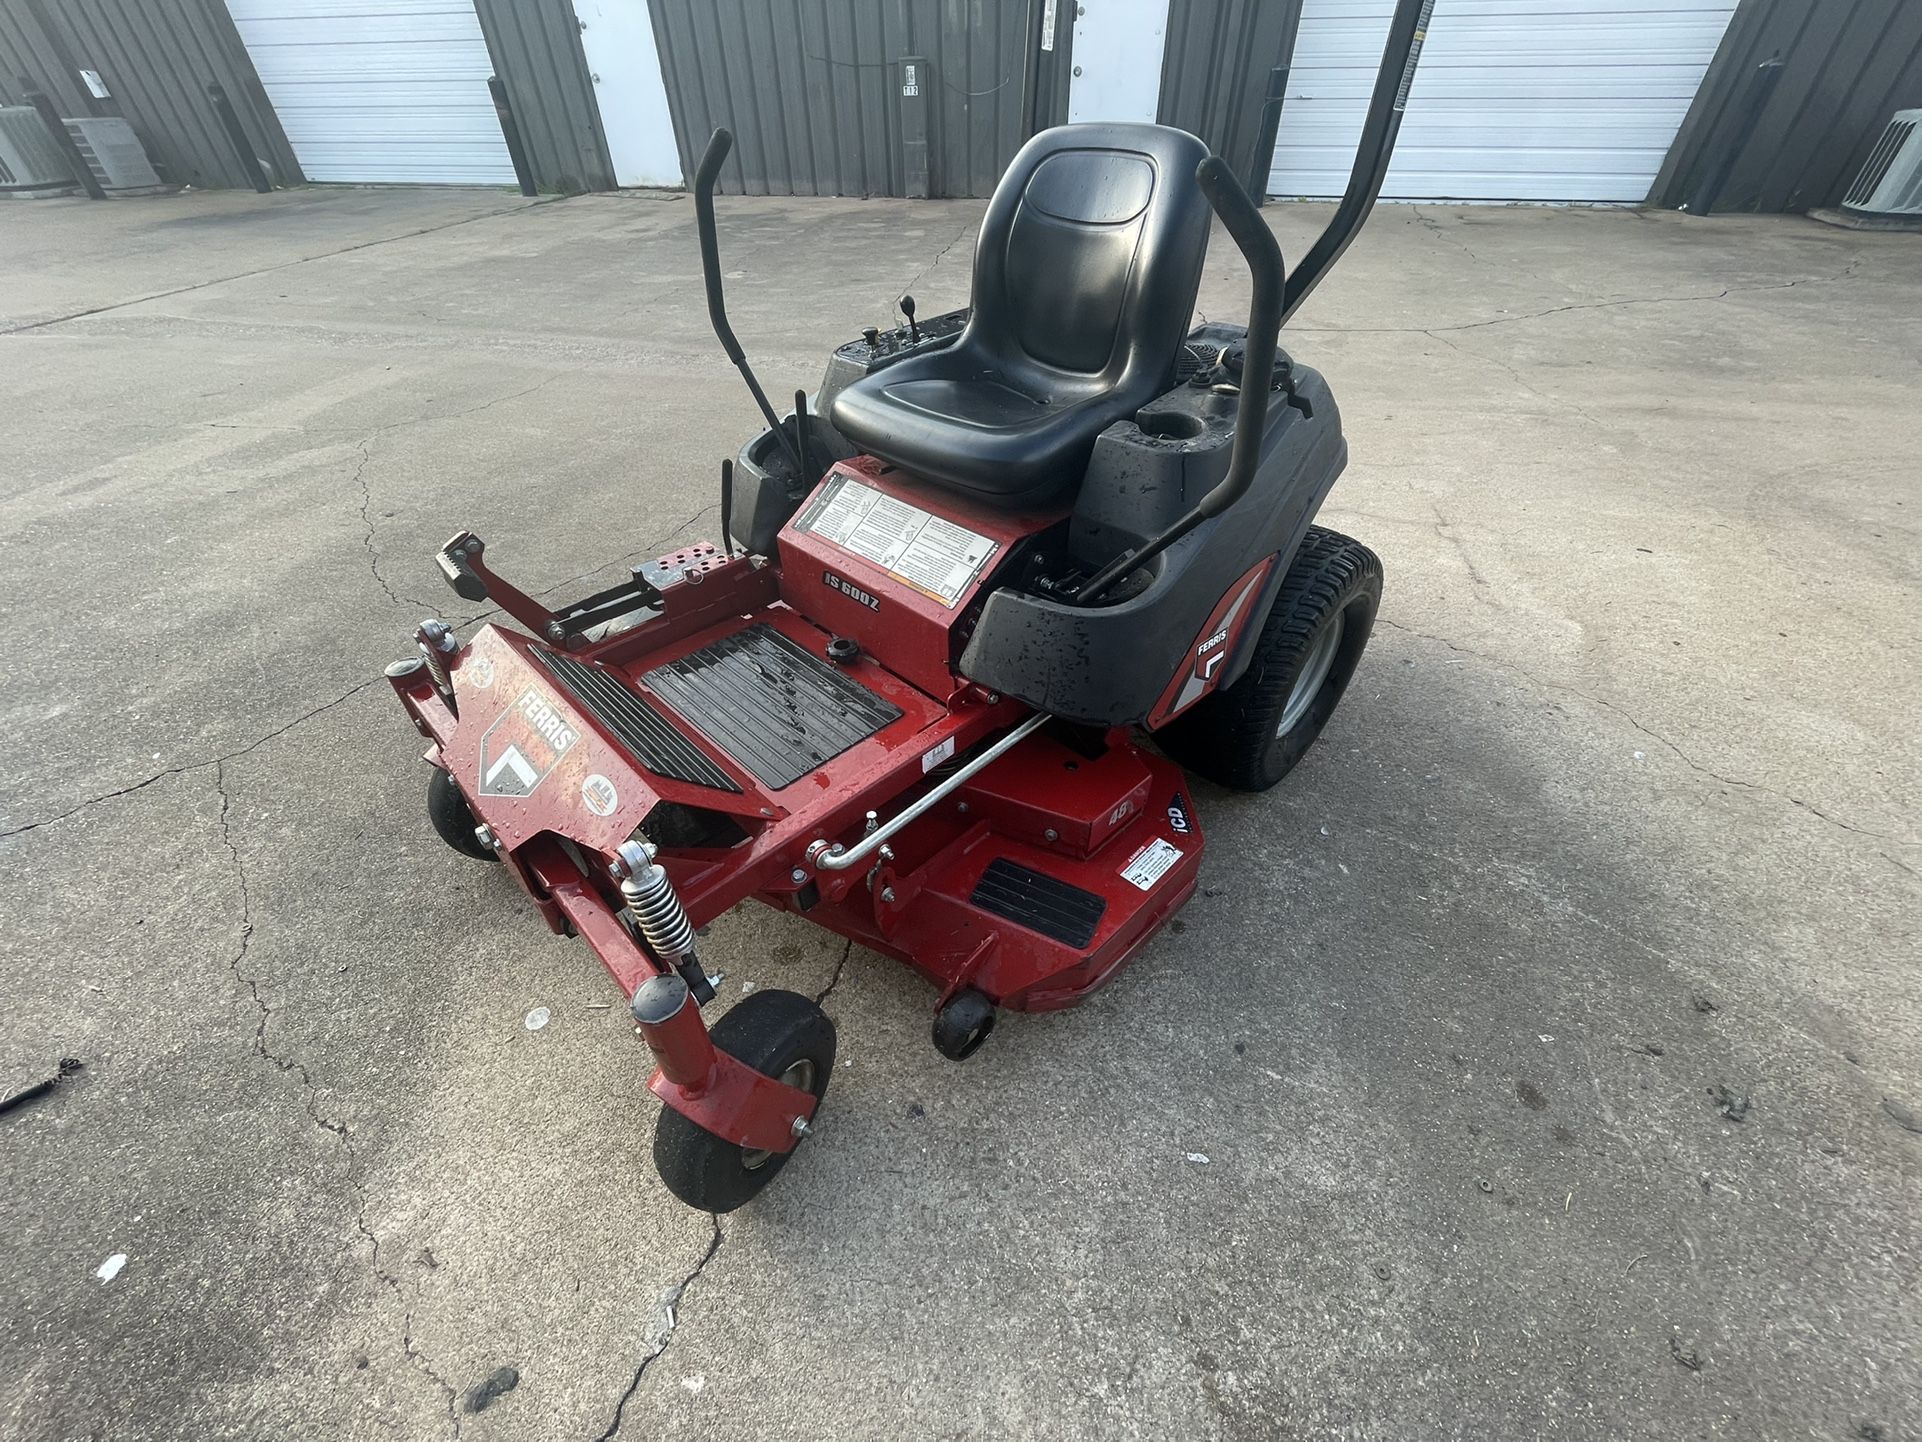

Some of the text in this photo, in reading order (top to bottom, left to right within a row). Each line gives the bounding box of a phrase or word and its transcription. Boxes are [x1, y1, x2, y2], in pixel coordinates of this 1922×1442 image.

[825, 572, 880, 612] IS 600Z
[1198, 629, 1227, 656] FERRIS
[517, 690, 572, 751] FERRIS
[1167, 807, 1189, 833] iCD
